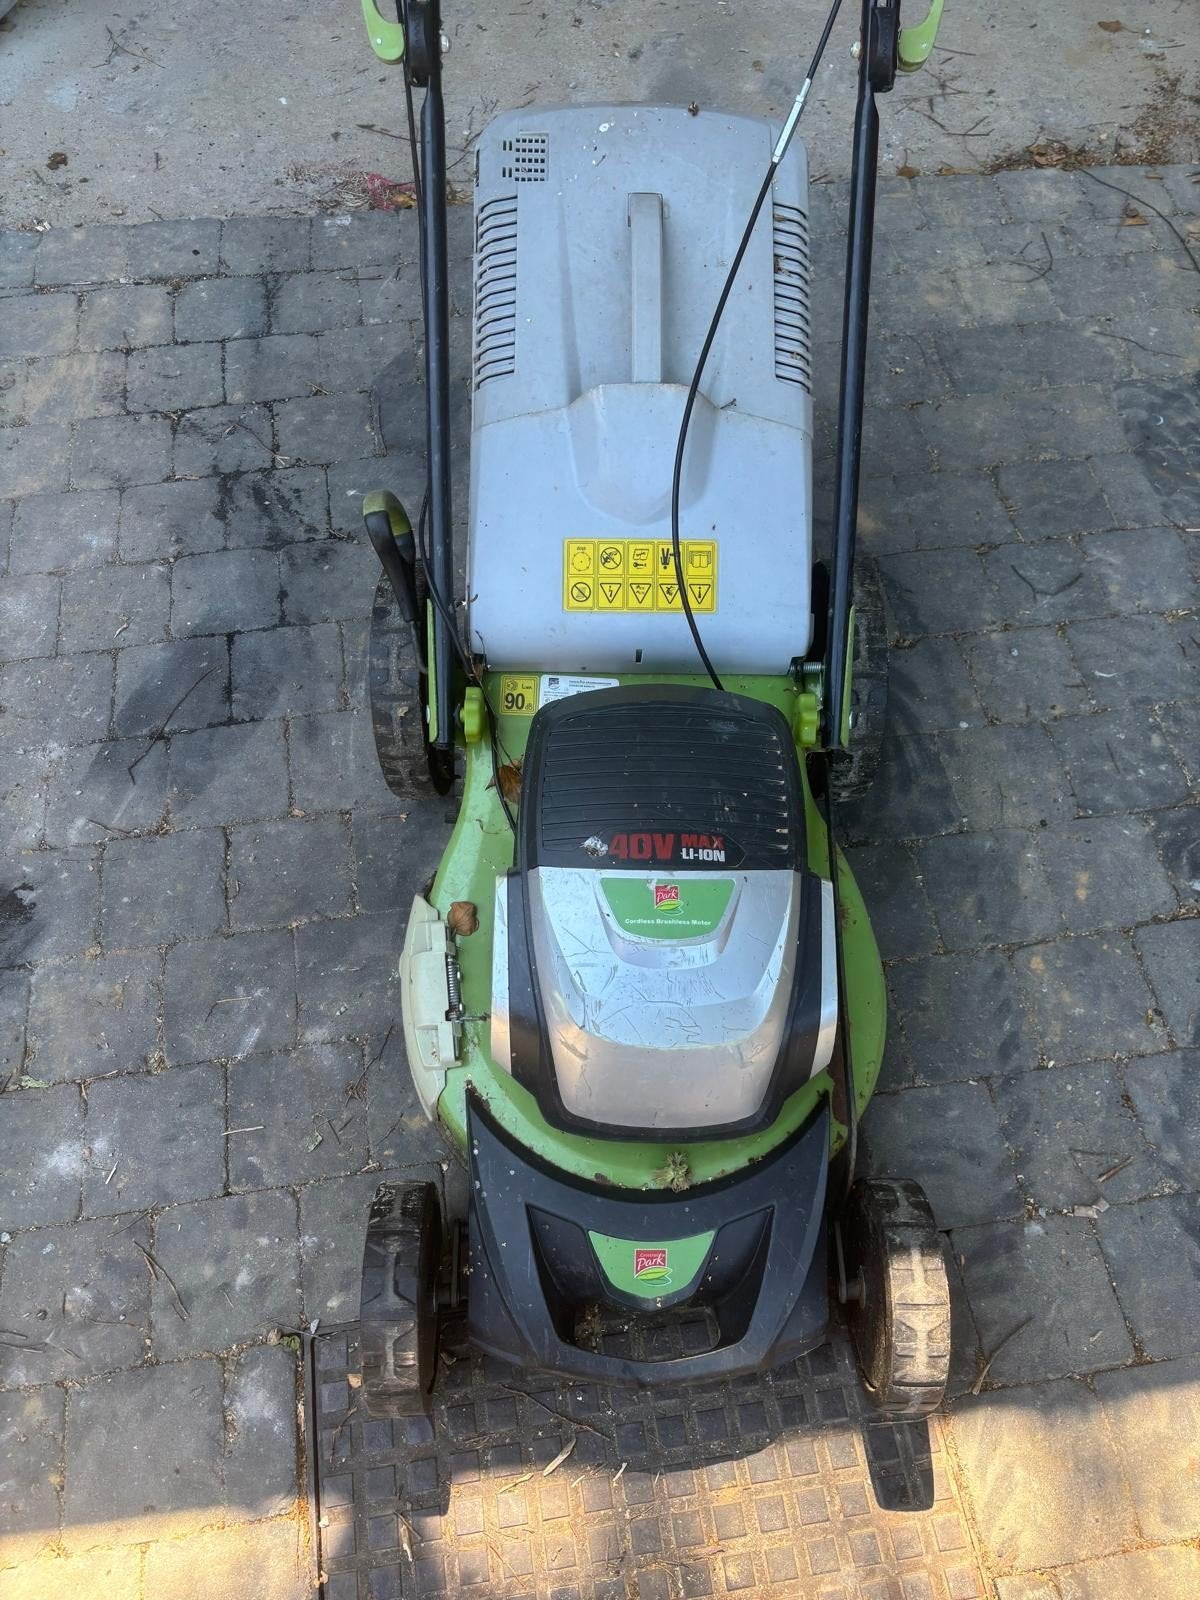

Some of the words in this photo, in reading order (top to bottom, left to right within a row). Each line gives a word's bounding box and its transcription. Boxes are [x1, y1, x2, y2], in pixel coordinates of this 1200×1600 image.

[505, 692, 525, 710] 90
[525, 702, 533, 711] dB
[608, 833, 674, 859] 40V
[681, 833, 725, 849] MAX
[681, 847, 726, 862] LI-ION
[656, 888, 678, 903] Park
[656, 918, 691, 926] Brushless
[637, 1253, 665, 1270] Park
